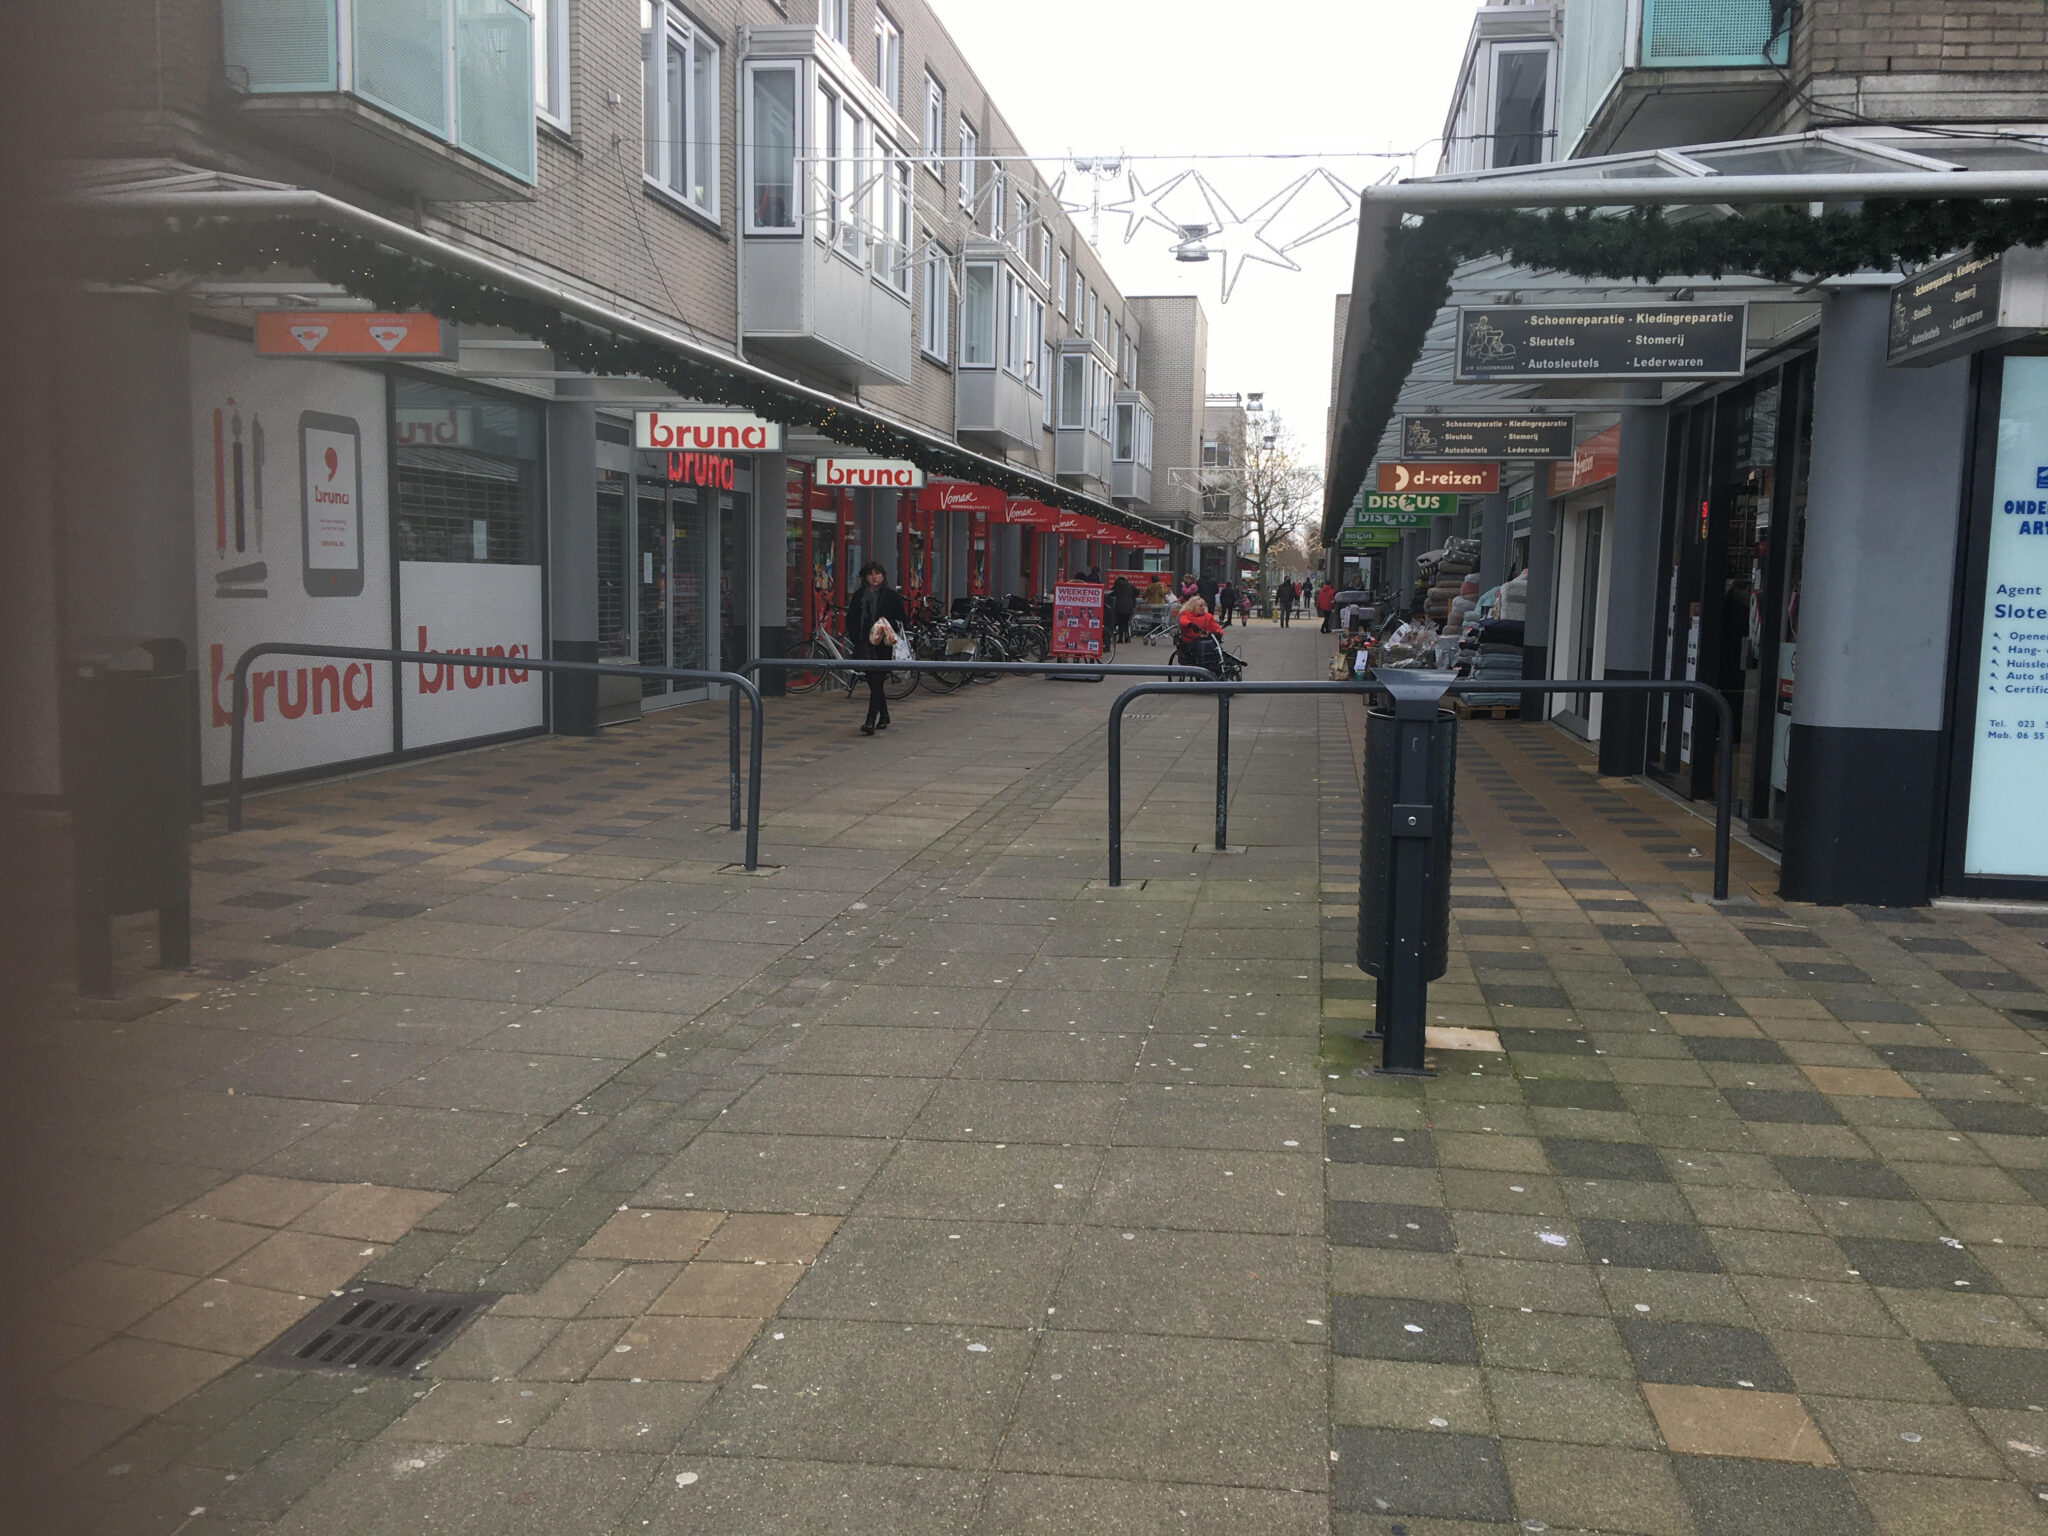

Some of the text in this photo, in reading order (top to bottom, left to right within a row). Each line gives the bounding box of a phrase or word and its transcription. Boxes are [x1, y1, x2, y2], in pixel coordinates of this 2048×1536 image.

[1530, 312, 1734, 327] Schoenreparatie Kledingreparatie
[1529, 334, 1685, 347] Sleutels Stomerij
[1528, 357, 1704, 369] Autosleutels Lederwaren
[1445, 419, 1568, 429] Schoenreparatie Kledingreparatie
[650, 413, 766, 449] bruna
[1444, 432, 1539, 441] Sleutels Stomerij
[1444, 446, 1488, 454] Autosleutels
[1507, 446, 1550, 454] Lederwaren
[826, 459, 913, 486] bruna
[1413, 471, 1482, 485] d-reizen
[315, 485, 350, 505] bruna
[1368, 494, 1440, 512] DISCUS
[1058, 588, 1100, 596] WEEKEND
[1996, 584, 2042, 598] Agent
[2009, 632, 2048, 642] Opene
[2008, 645, 2042, 656] Hang-
[417, 626, 529, 695] bruna
[2006, 659, 2048, 669] Huissle
[2006, 672, 2034, 681] Auto
[211, 643, 373, 728] bruna
[1989, 720, 2035, 728] Tel. 023
[1988, 731, 2045, 740] Mob. 06 55
